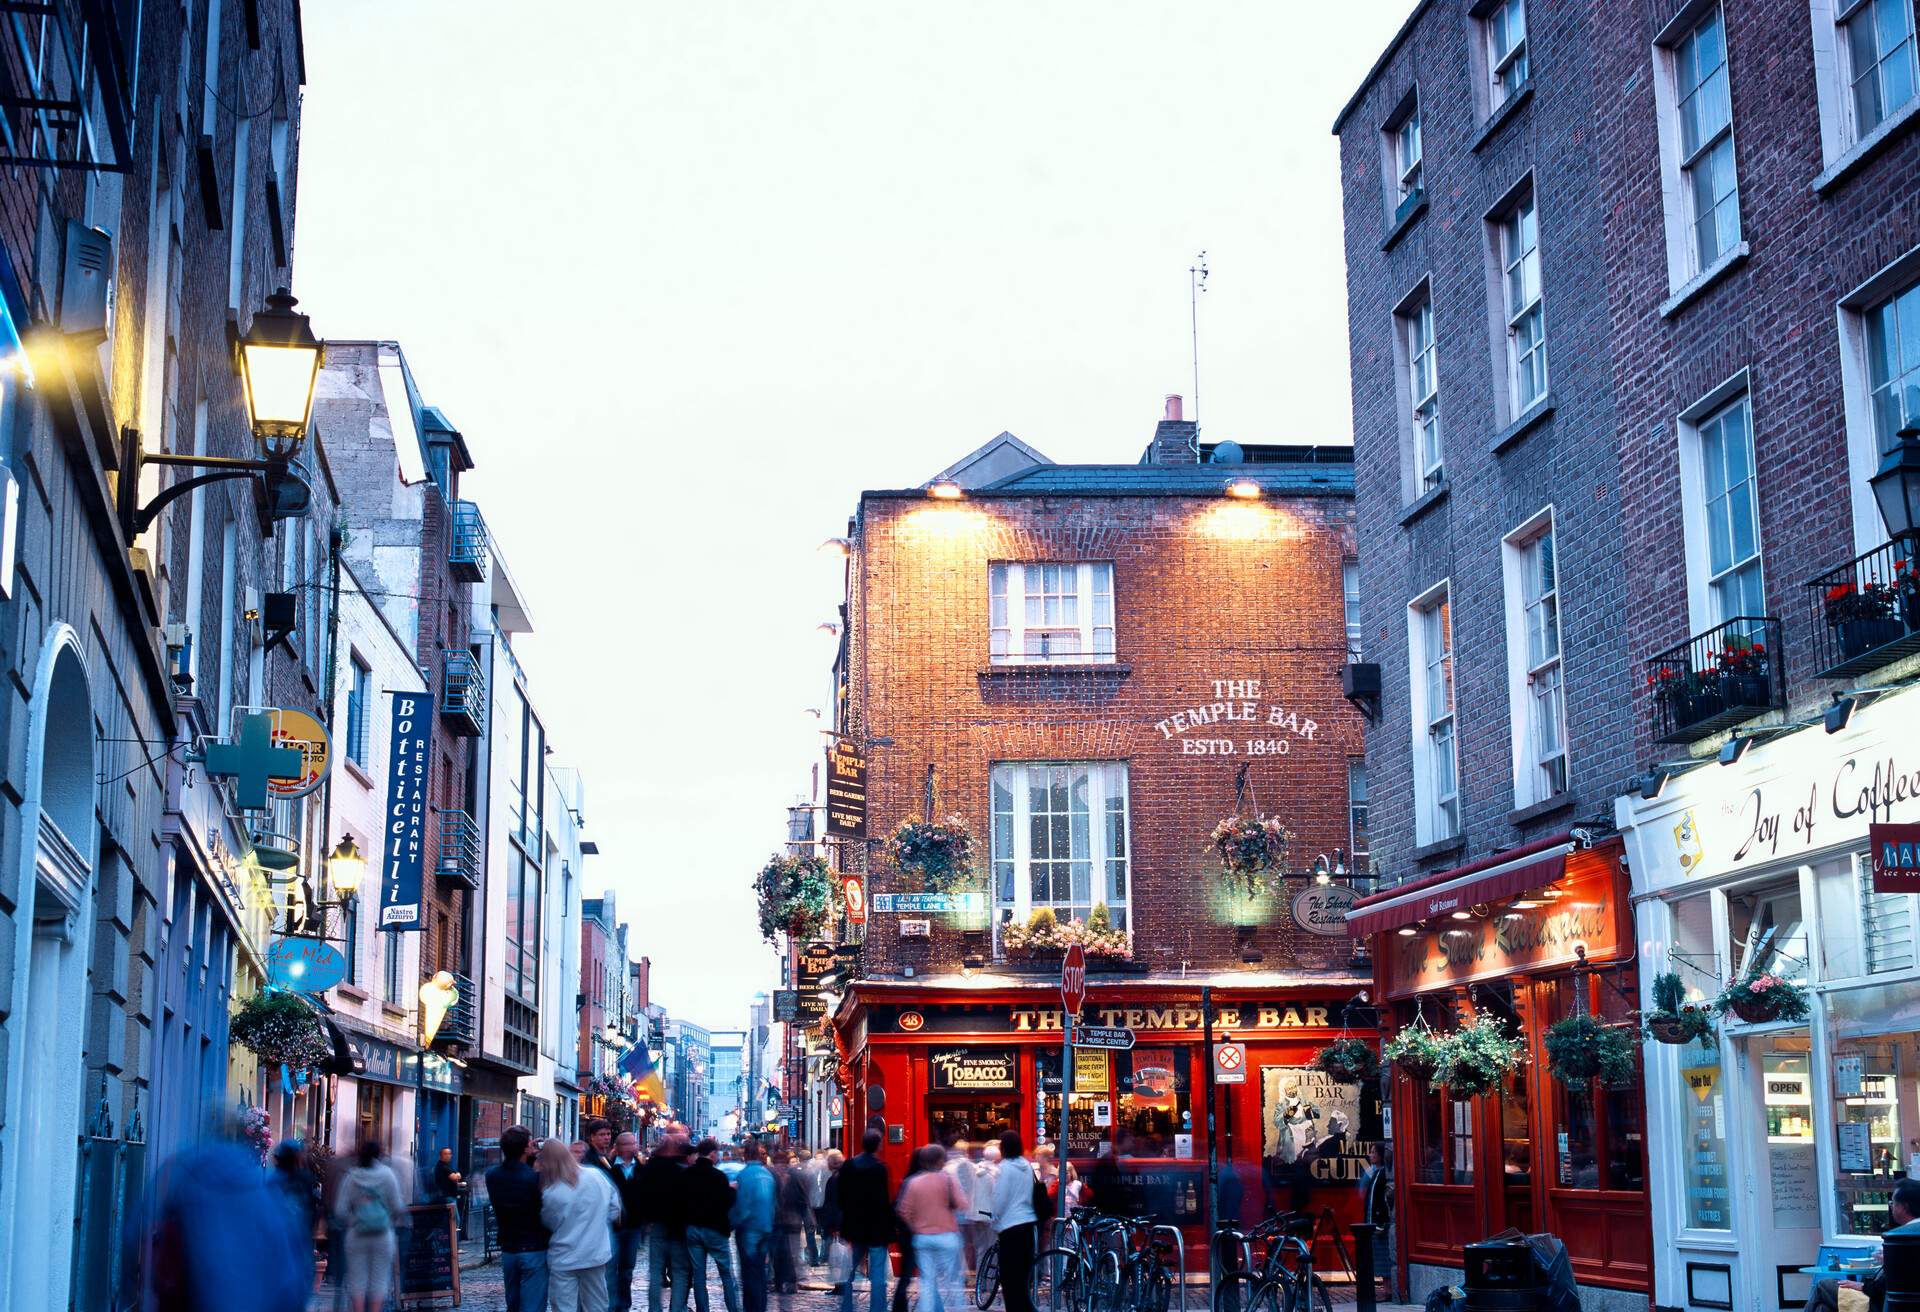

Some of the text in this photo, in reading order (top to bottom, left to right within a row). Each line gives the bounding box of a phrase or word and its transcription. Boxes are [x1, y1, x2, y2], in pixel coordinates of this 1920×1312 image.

[1211, 680, 1261, 699] THE
[1154, 702, 1318, 740] TEMPLE BAR
[841, 744, 854, 753] THE
[1182, 739, 1289, 755] ESTD. 1840
[828, 750, 866, 769] TEMPLE
[836, 763, 859, 778] BAR
[390, 699, 415, 902] Botticelli
[409, 739, 424, 863] RESTAURANT
[829, 788, 865, 801] BEER GARDEN
[1733, 788, 1780, 861] Joy
[1793, 782, 1817, 844] of
[1832, 757, 1920, 824] Coffee
[831, 812, 863, 823] LIVE MUSIC
[839, 819, 856, 828] DAILY
[1309, 896, 1324, 910] The
[386, 913, 414, 921] Azzurro
[1063, 966, 1084, 993] STOP
[903, 1014, 919, 1026] 48
[1257, 1007, 1329, 1028] BAR
[1090, 1030, 1113, 1038] TEMPLE
[1106, 1038, 1129, 1046] CENTRE
[941, 1063, 1007, 1086] TOBACCO
[1690, 1074, 1712, 1088] Take Out
[1314, 1087, 1344, 1099] BAR
[1770, 1083, 1800, 1093] OPEN
[1054, 1132, 1103, 1141] LIE MUSIC
